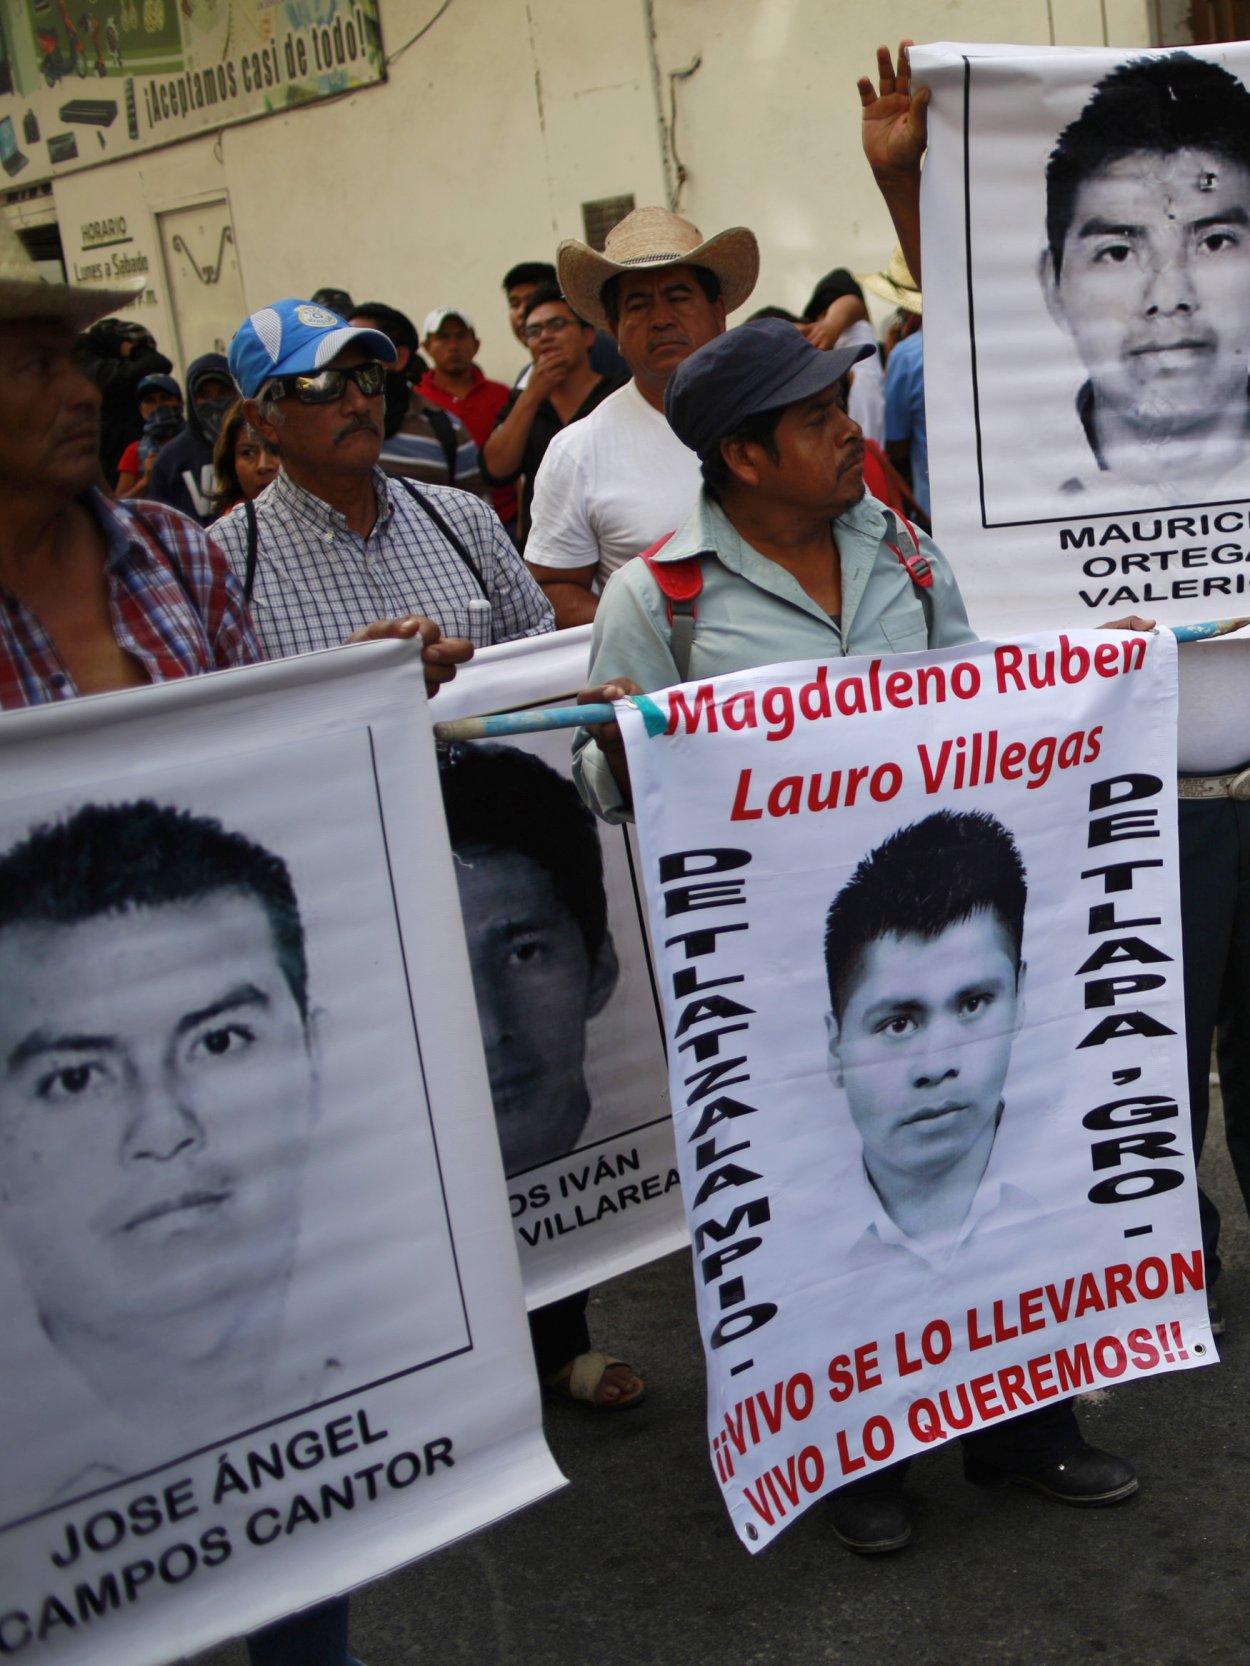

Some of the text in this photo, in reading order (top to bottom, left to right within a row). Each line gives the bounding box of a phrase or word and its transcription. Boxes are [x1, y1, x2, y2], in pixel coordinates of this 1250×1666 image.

[144, 8, 366, 128] ¡Aceptamos casi de todo!
[81, 216, 127, 241] HORARIO
[665, 635, 1147, 742] Magdaleno Ruben
[730, 725, 1103, 822] Lauro Villegas
[518, 1168, 681, 1246] VILLAREA
[558, 1148, 640, 1198] IVÁN
[828, 1341, 882, 1403] SE
[895, 1319, 952, 1377] LO
[967, 1249, 1205, 1352] LLEVARON
[743, 1321, 1189, 1527] VIVO LO QUEREMOS!!
[51, 1409, 388, 1568] JOSE ÁNGEL
[0, 1437, 456, 1654] CAMPOS CANTOR
